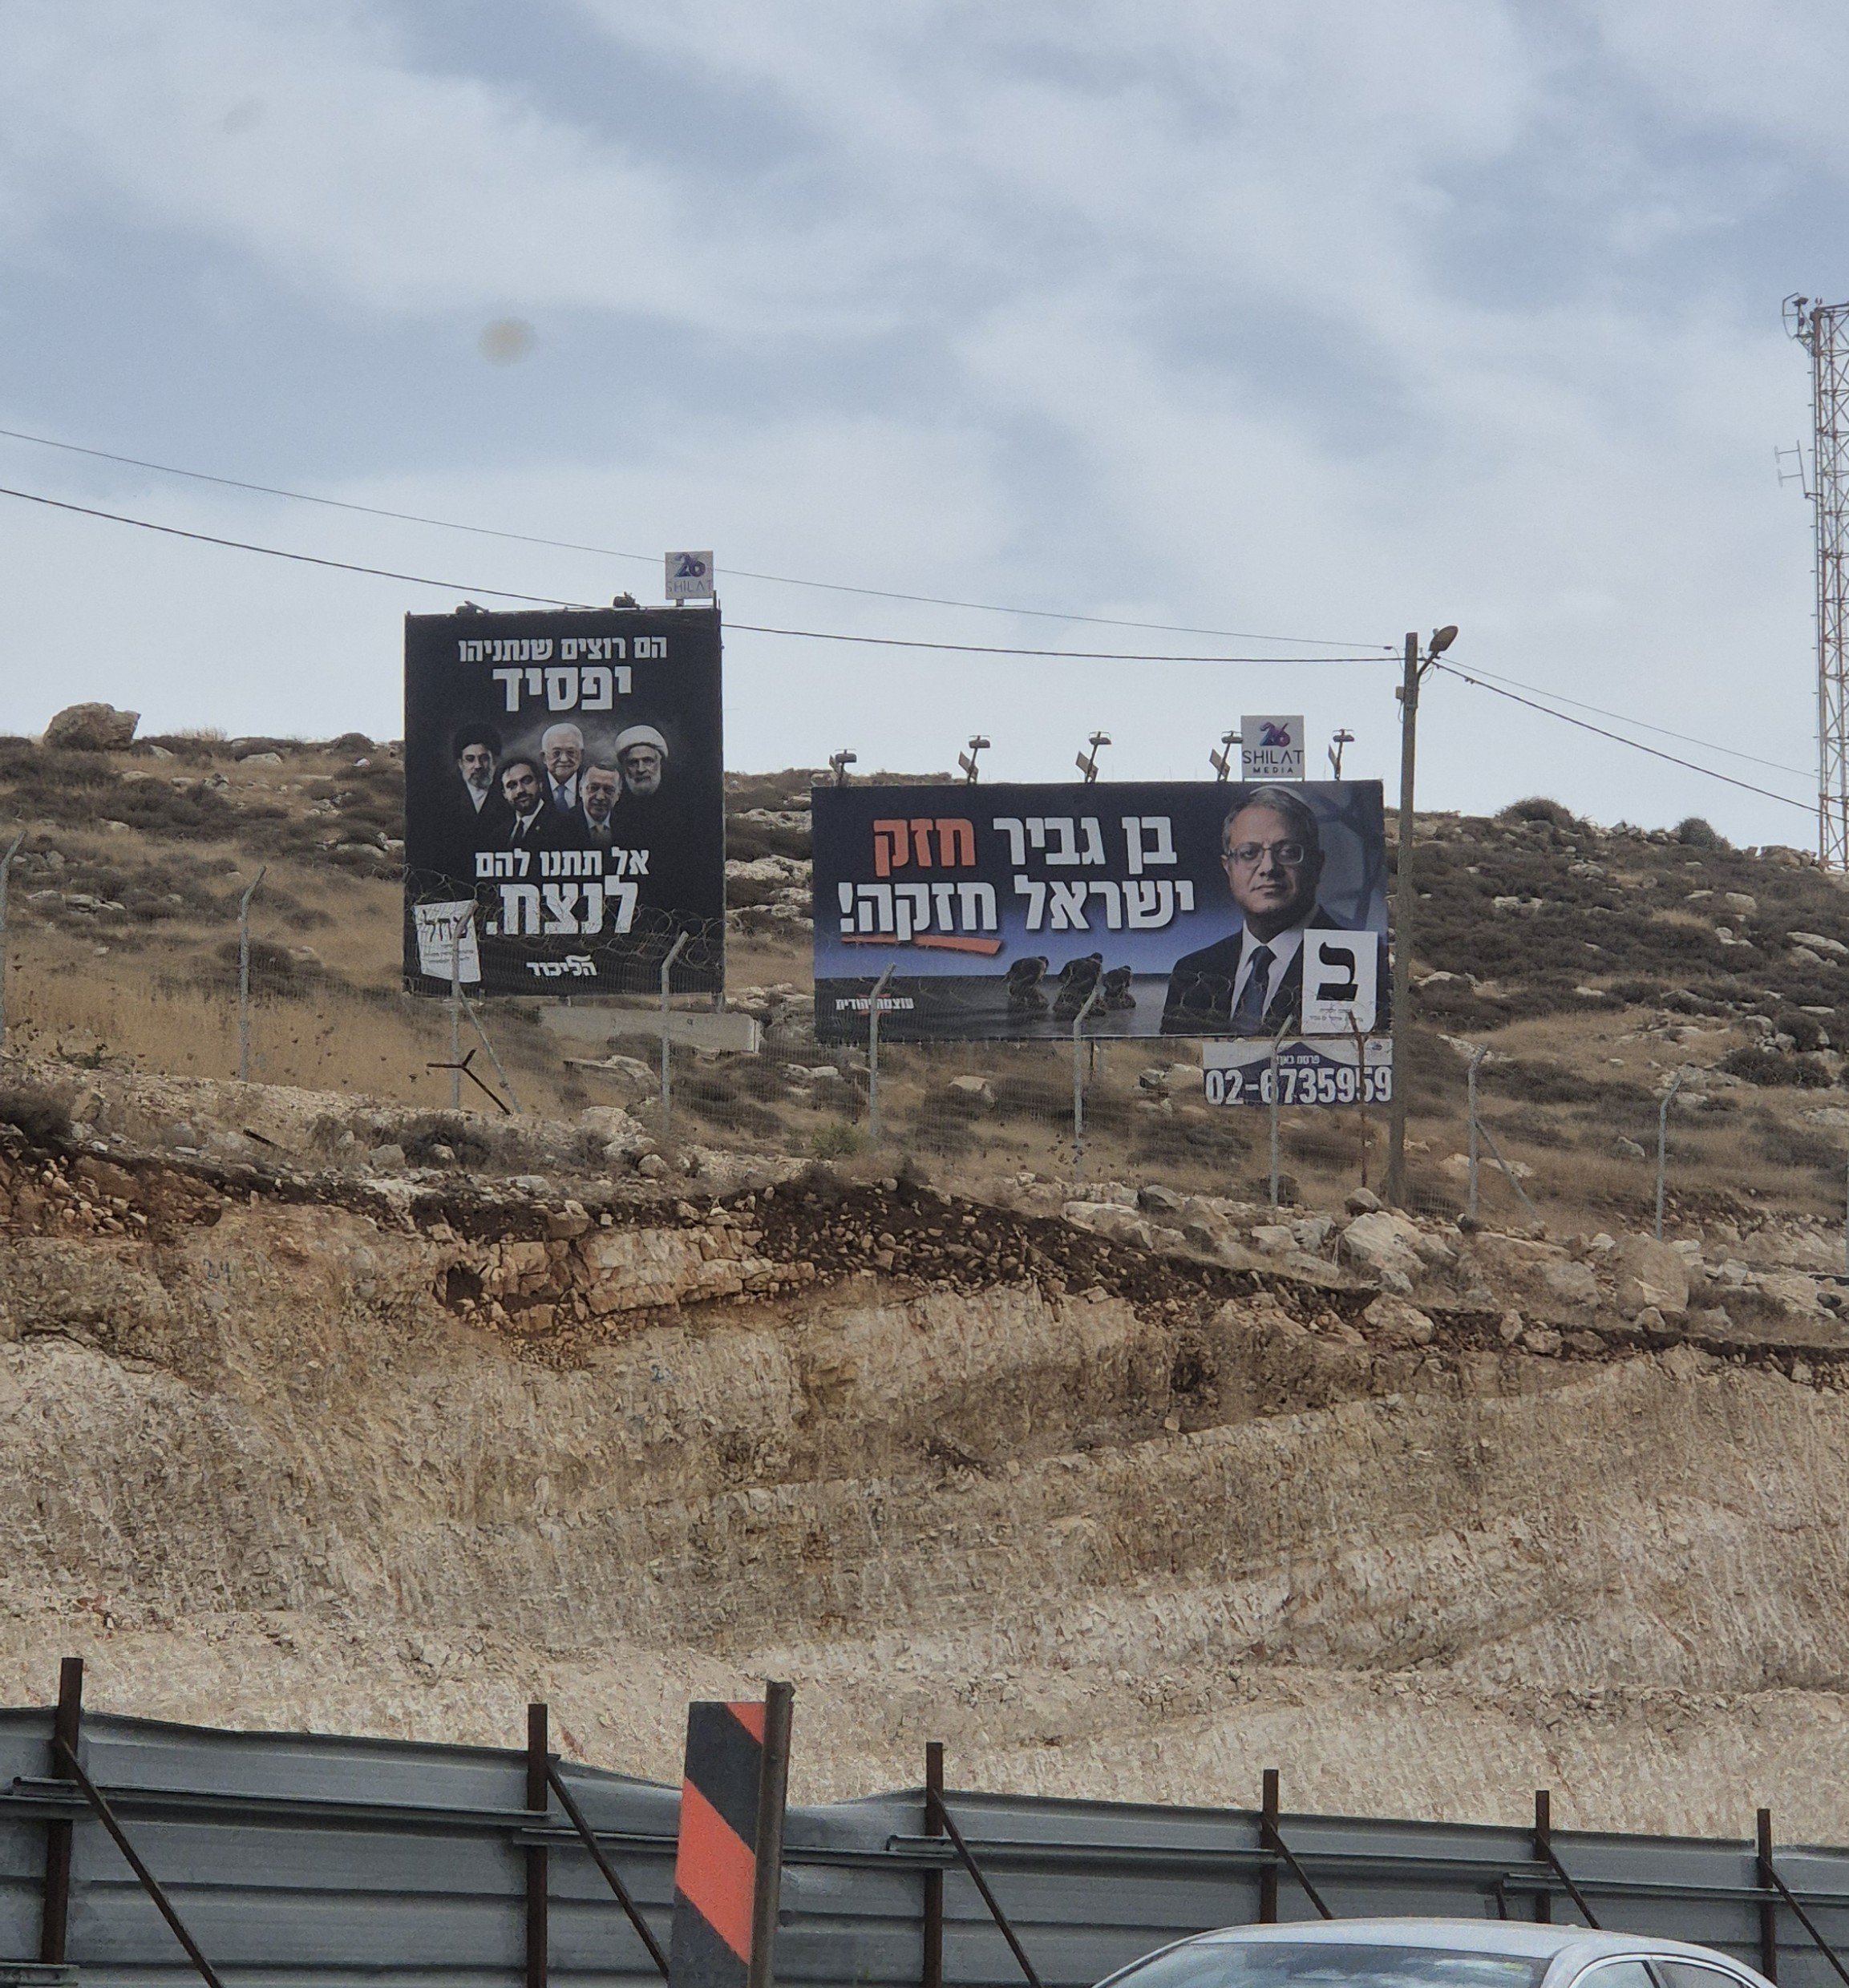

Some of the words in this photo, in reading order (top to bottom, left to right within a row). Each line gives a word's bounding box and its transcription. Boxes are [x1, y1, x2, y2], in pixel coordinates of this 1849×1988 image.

[458, 640, 553, 661] שנתניהו
[561, 638, 626, 660] רוצים
[633, 637, 667, 658] הם
[492, 666, 632, 711] יפסיד
[1242, 750, 1304, 764] SHILAT
[873, 818, 976, 877] חזק
[993, 817, 1106, 865] גביר
[1123, 817, 1177, 875] בן
[475, 848, 531, 877] להם
[540, 851, 602, 876] תתנו
[611, 847, 649, 875] אל
[486, 875, 638, 935] לנצח.
[838, 882, 998, 941] חזקה!
[1014, 875, 1195, 930] ישראל
[526, 955, 597, 976] הליכוד
[1316, 941, 1359, 1001] ב
[876, 997, 914, 1009] עוצמה
[1205, 1066, 1392, 1105] 02-6735959
